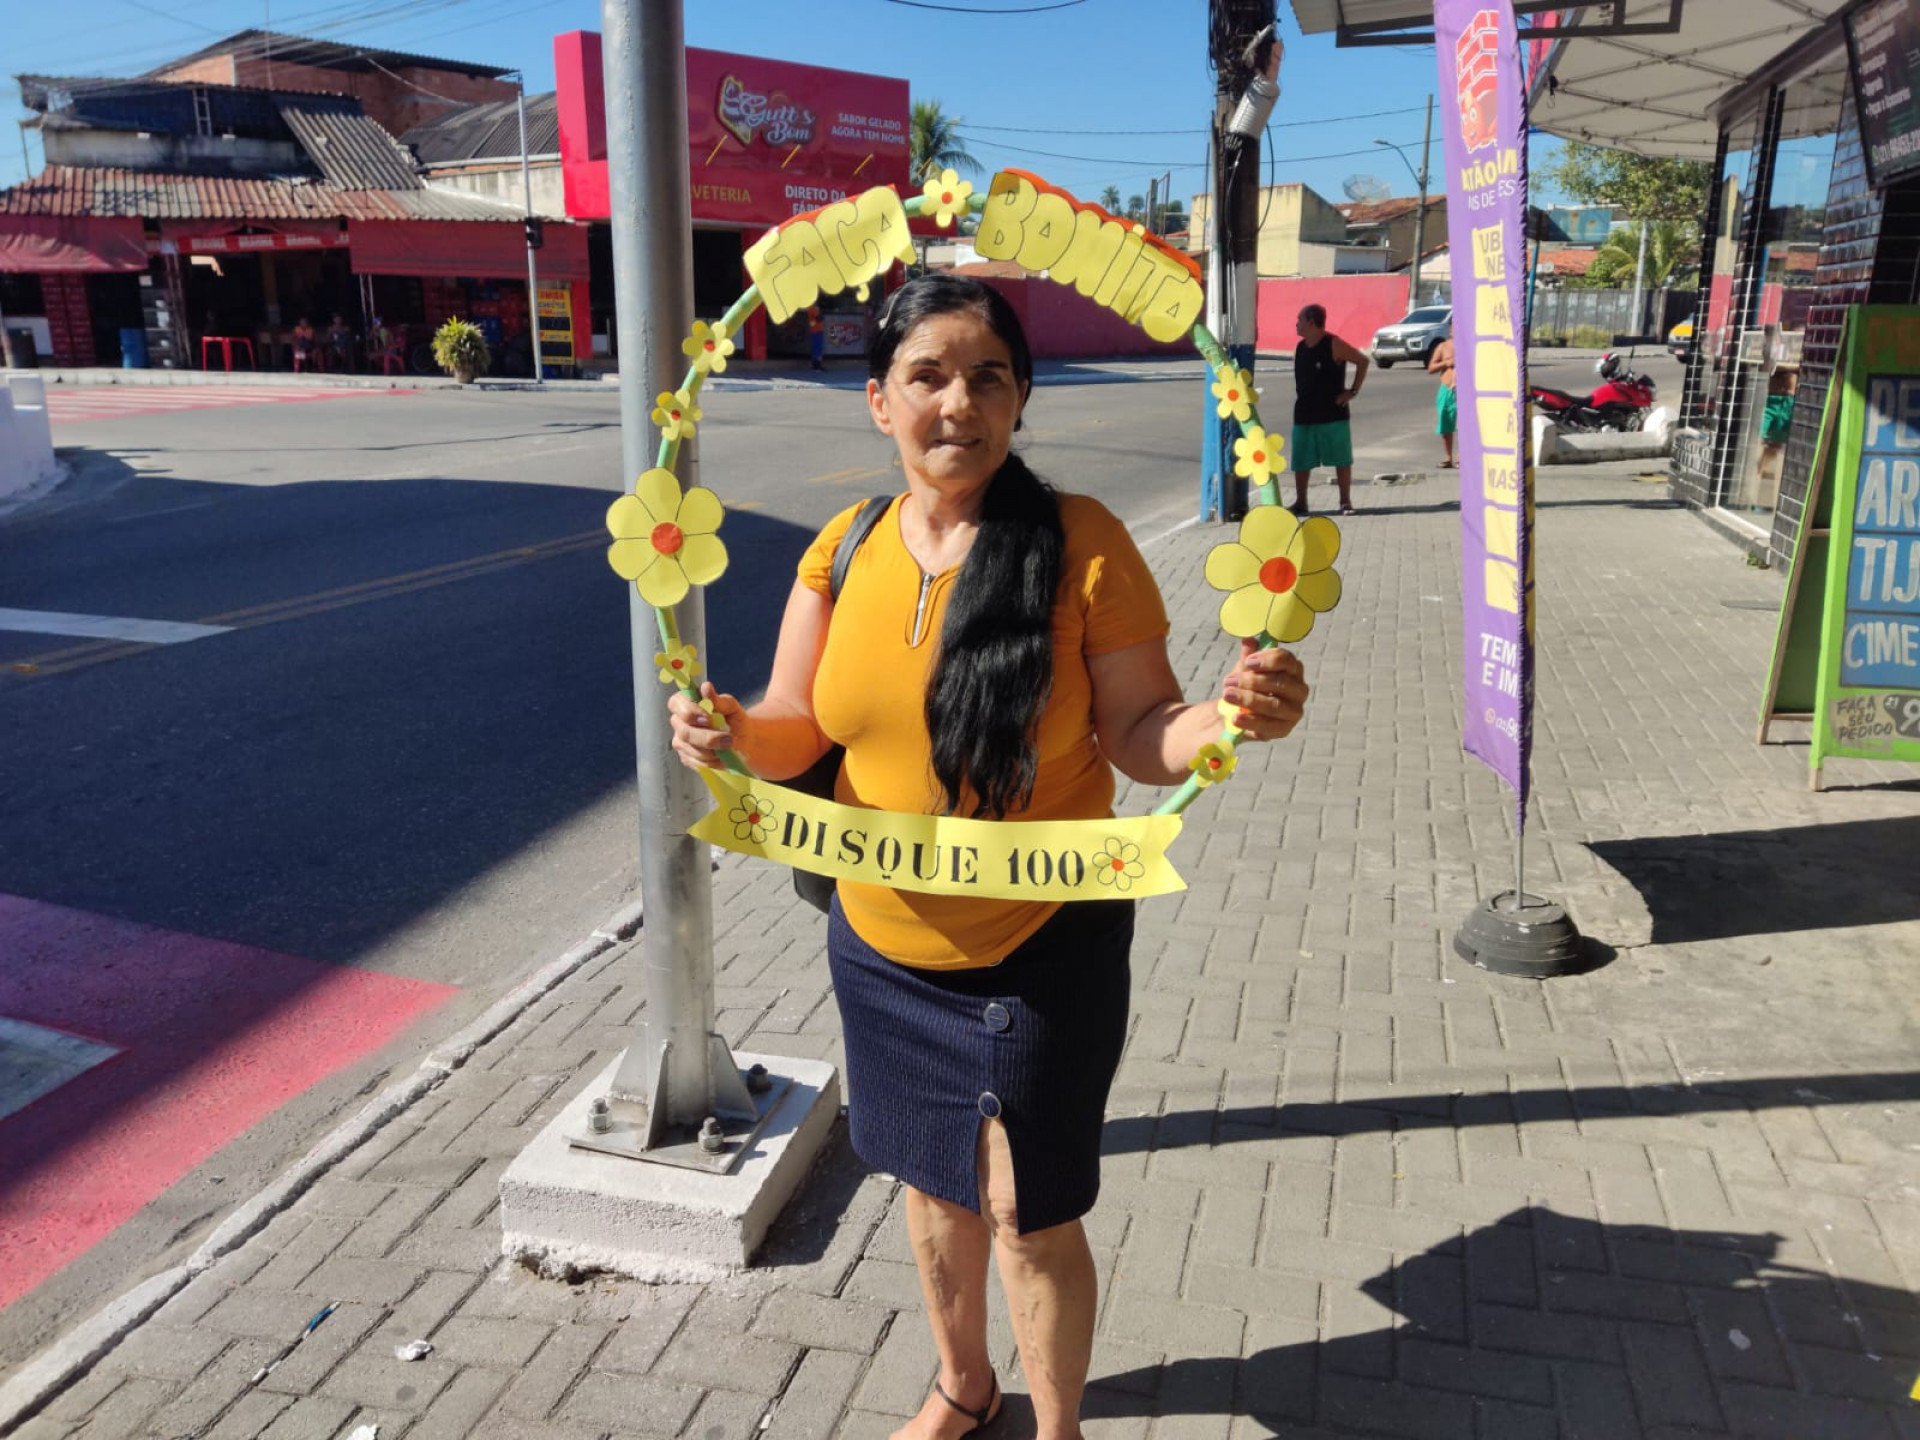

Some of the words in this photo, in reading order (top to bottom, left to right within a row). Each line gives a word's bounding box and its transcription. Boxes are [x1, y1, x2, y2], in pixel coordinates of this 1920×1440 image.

[868, 117, 901, 131] GELADO
[831, 126, 861, 139] AGORA
[863, 130, 880, 141] TEM
[881, 133, 905, 145] NOME
[785, 184, 828, 201] DIRETO
[831, 190, 847, 204] DA
[1481, 190, 1496, 208] DE
[1481, 632, 1518, 668] TEM
[1844, 620, 1920, 669] CIME
[1482, 662, 1495, 686] E
[1838, 722, 1893, 741] PEDIDO
[779, 811, 979, 884] DISQUE
[1007, 847, 1085, 887] 100
